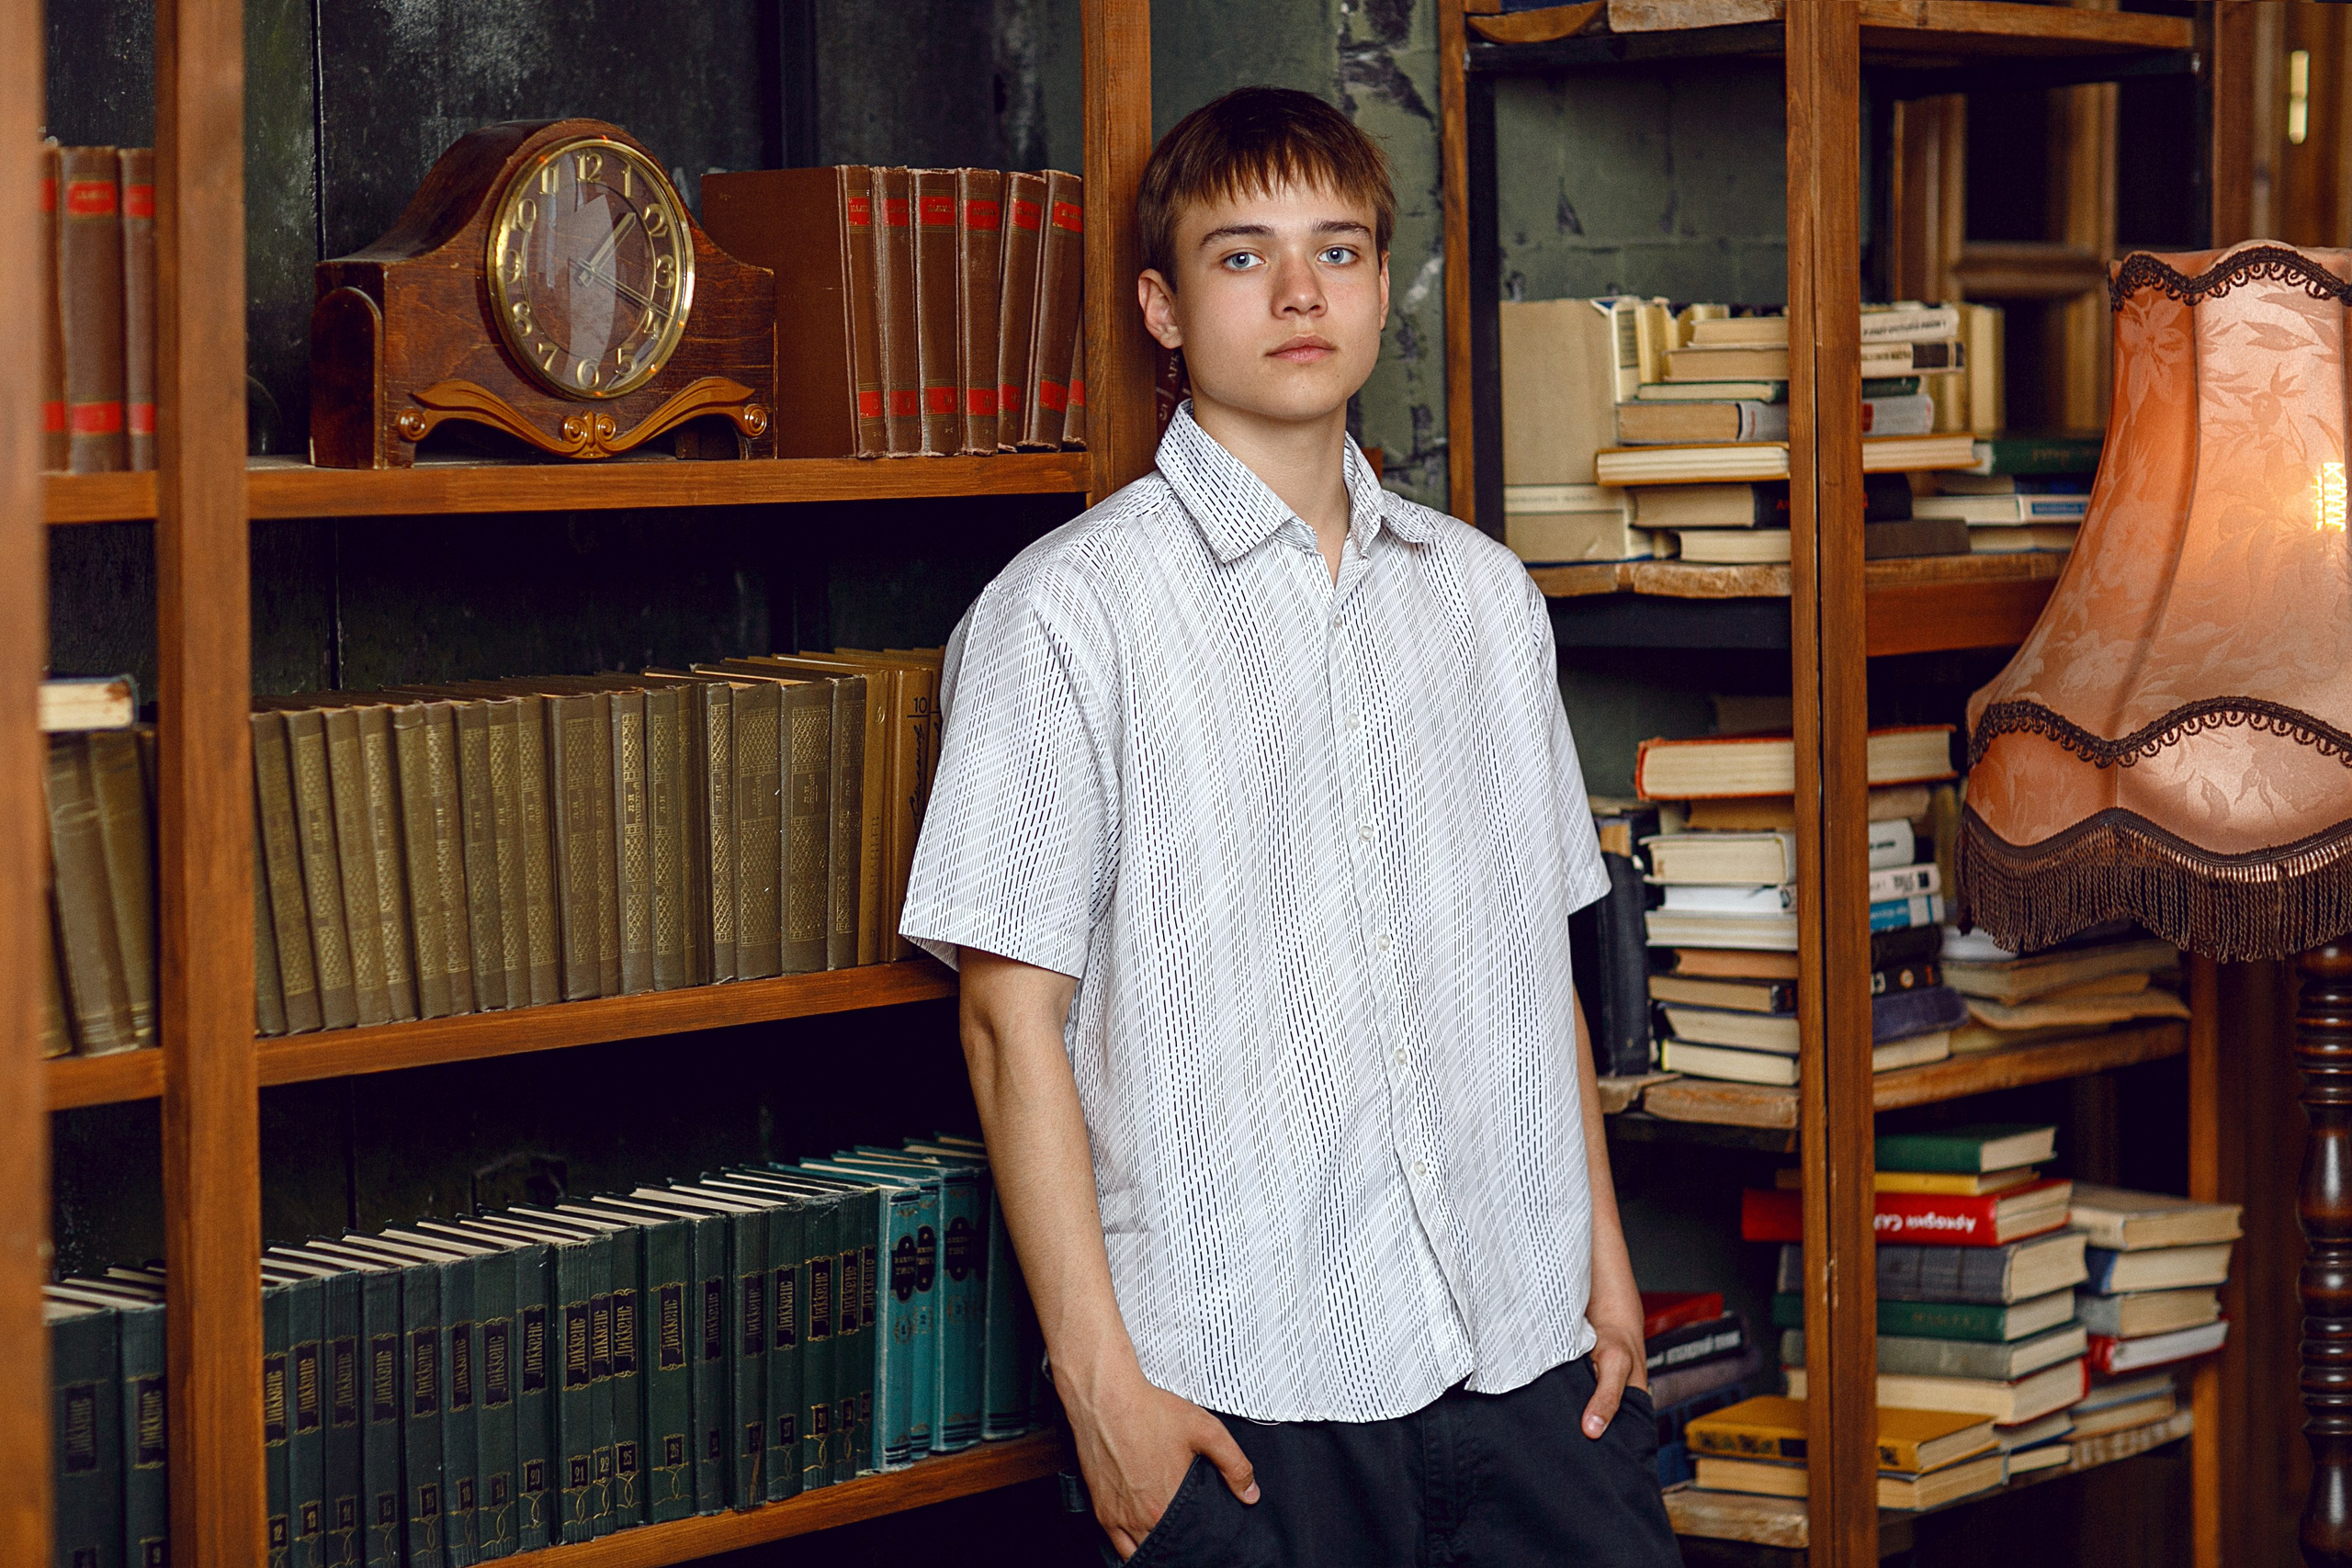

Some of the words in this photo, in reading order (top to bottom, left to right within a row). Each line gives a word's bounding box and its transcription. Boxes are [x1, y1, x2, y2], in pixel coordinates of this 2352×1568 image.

[539, 163, 560, 196] 11
[577, 152, 603, 183] 12
[622, 163, 631, 198] 1
[645, 203, 669, 238] 2
[505, 249, 521, 284] 9
[655, 254, 675, 289] 3
[513, 300, 532, 337] 8
[538, 342, 560, 371] 7
[576, 357, 600, 389] 6
[615, 342, 638, 376] 5
[913, 696, 928, 714] 10
[706, 1292, 720, 1346] Диккенс
[746, 1287, 763, 1340] Диккенс
[777, 1280, 794, 1336] Диккенс
[812, 1271, 829, 1326] Диккенс
[843, 1265, 857, 1320] Диккенс
[525, 1322, 544, 1378] Диккенс
[568, 1318, 587, 1374] Диккенс
[593, 1309, 610, 1365] Диккенс
[615, 1305, 635, 1362] Диккенс
[662, 1299, 681, 1355] Диккенс
[299, 1358, 318, 1416] Диккенс
[335, 1352, 355, 1409] Диккенс
[374, 1350, 394, 1407] Диккенс
[415, 1344, 435, 1400] Диккенс
[455, 1338, 469, 1394] Диккенс
[488, 1336, 507, 1392] Диккенс
[265, 1370, 284, 1427] Диккенс
[530, 1468, 540, 1485] 20
[574, 1466, 584, 1483] 21
[600, 1456, 610, 1472] 22
